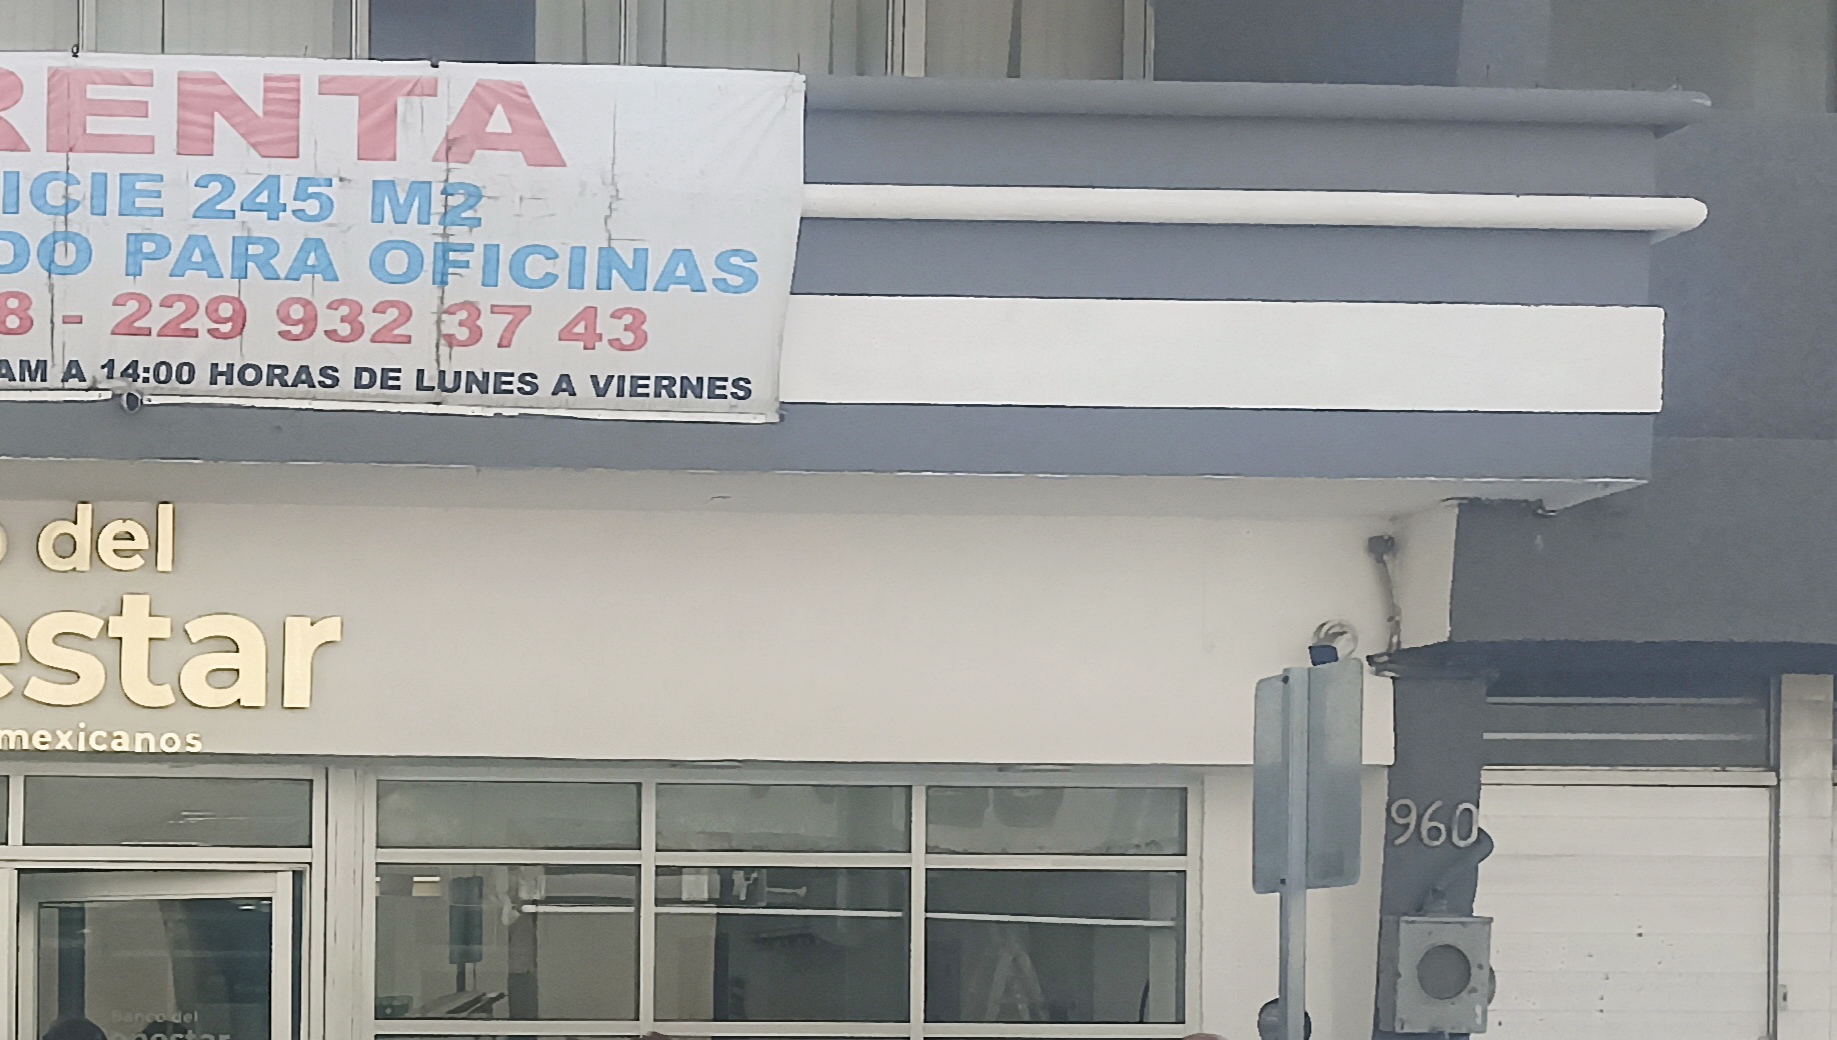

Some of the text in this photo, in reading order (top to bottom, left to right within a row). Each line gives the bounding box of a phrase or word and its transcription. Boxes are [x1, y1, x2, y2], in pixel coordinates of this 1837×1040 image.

[192, 173, 335, 223] 245
[370, 179, 484, 229] M2
[124, 232, 339, 282] PARA
[369, 240, 760, 294] OFICINAS
[62, 314, 83, 325] -
[110, 292, 247, 341] 229
[276, 298, 413, 345] 932
[440, 302, 532, 349] 37
[558, 305, 649, 352] 43
[61, 361, 87, 386] A
[99, 358, 196, 387] 14:00
[209, 361, 344, 391] HORAS
[353, 365, 402, 391] DE
[415, 368, 539, 397] LUNES
[551, 372, 577, 397] A
[591, 373, 753, 401] VIERNES
[36, 501, 175, 573] del
[1391, 798, 1479, 848] 960
[168, 1010, 198, 1023] del
